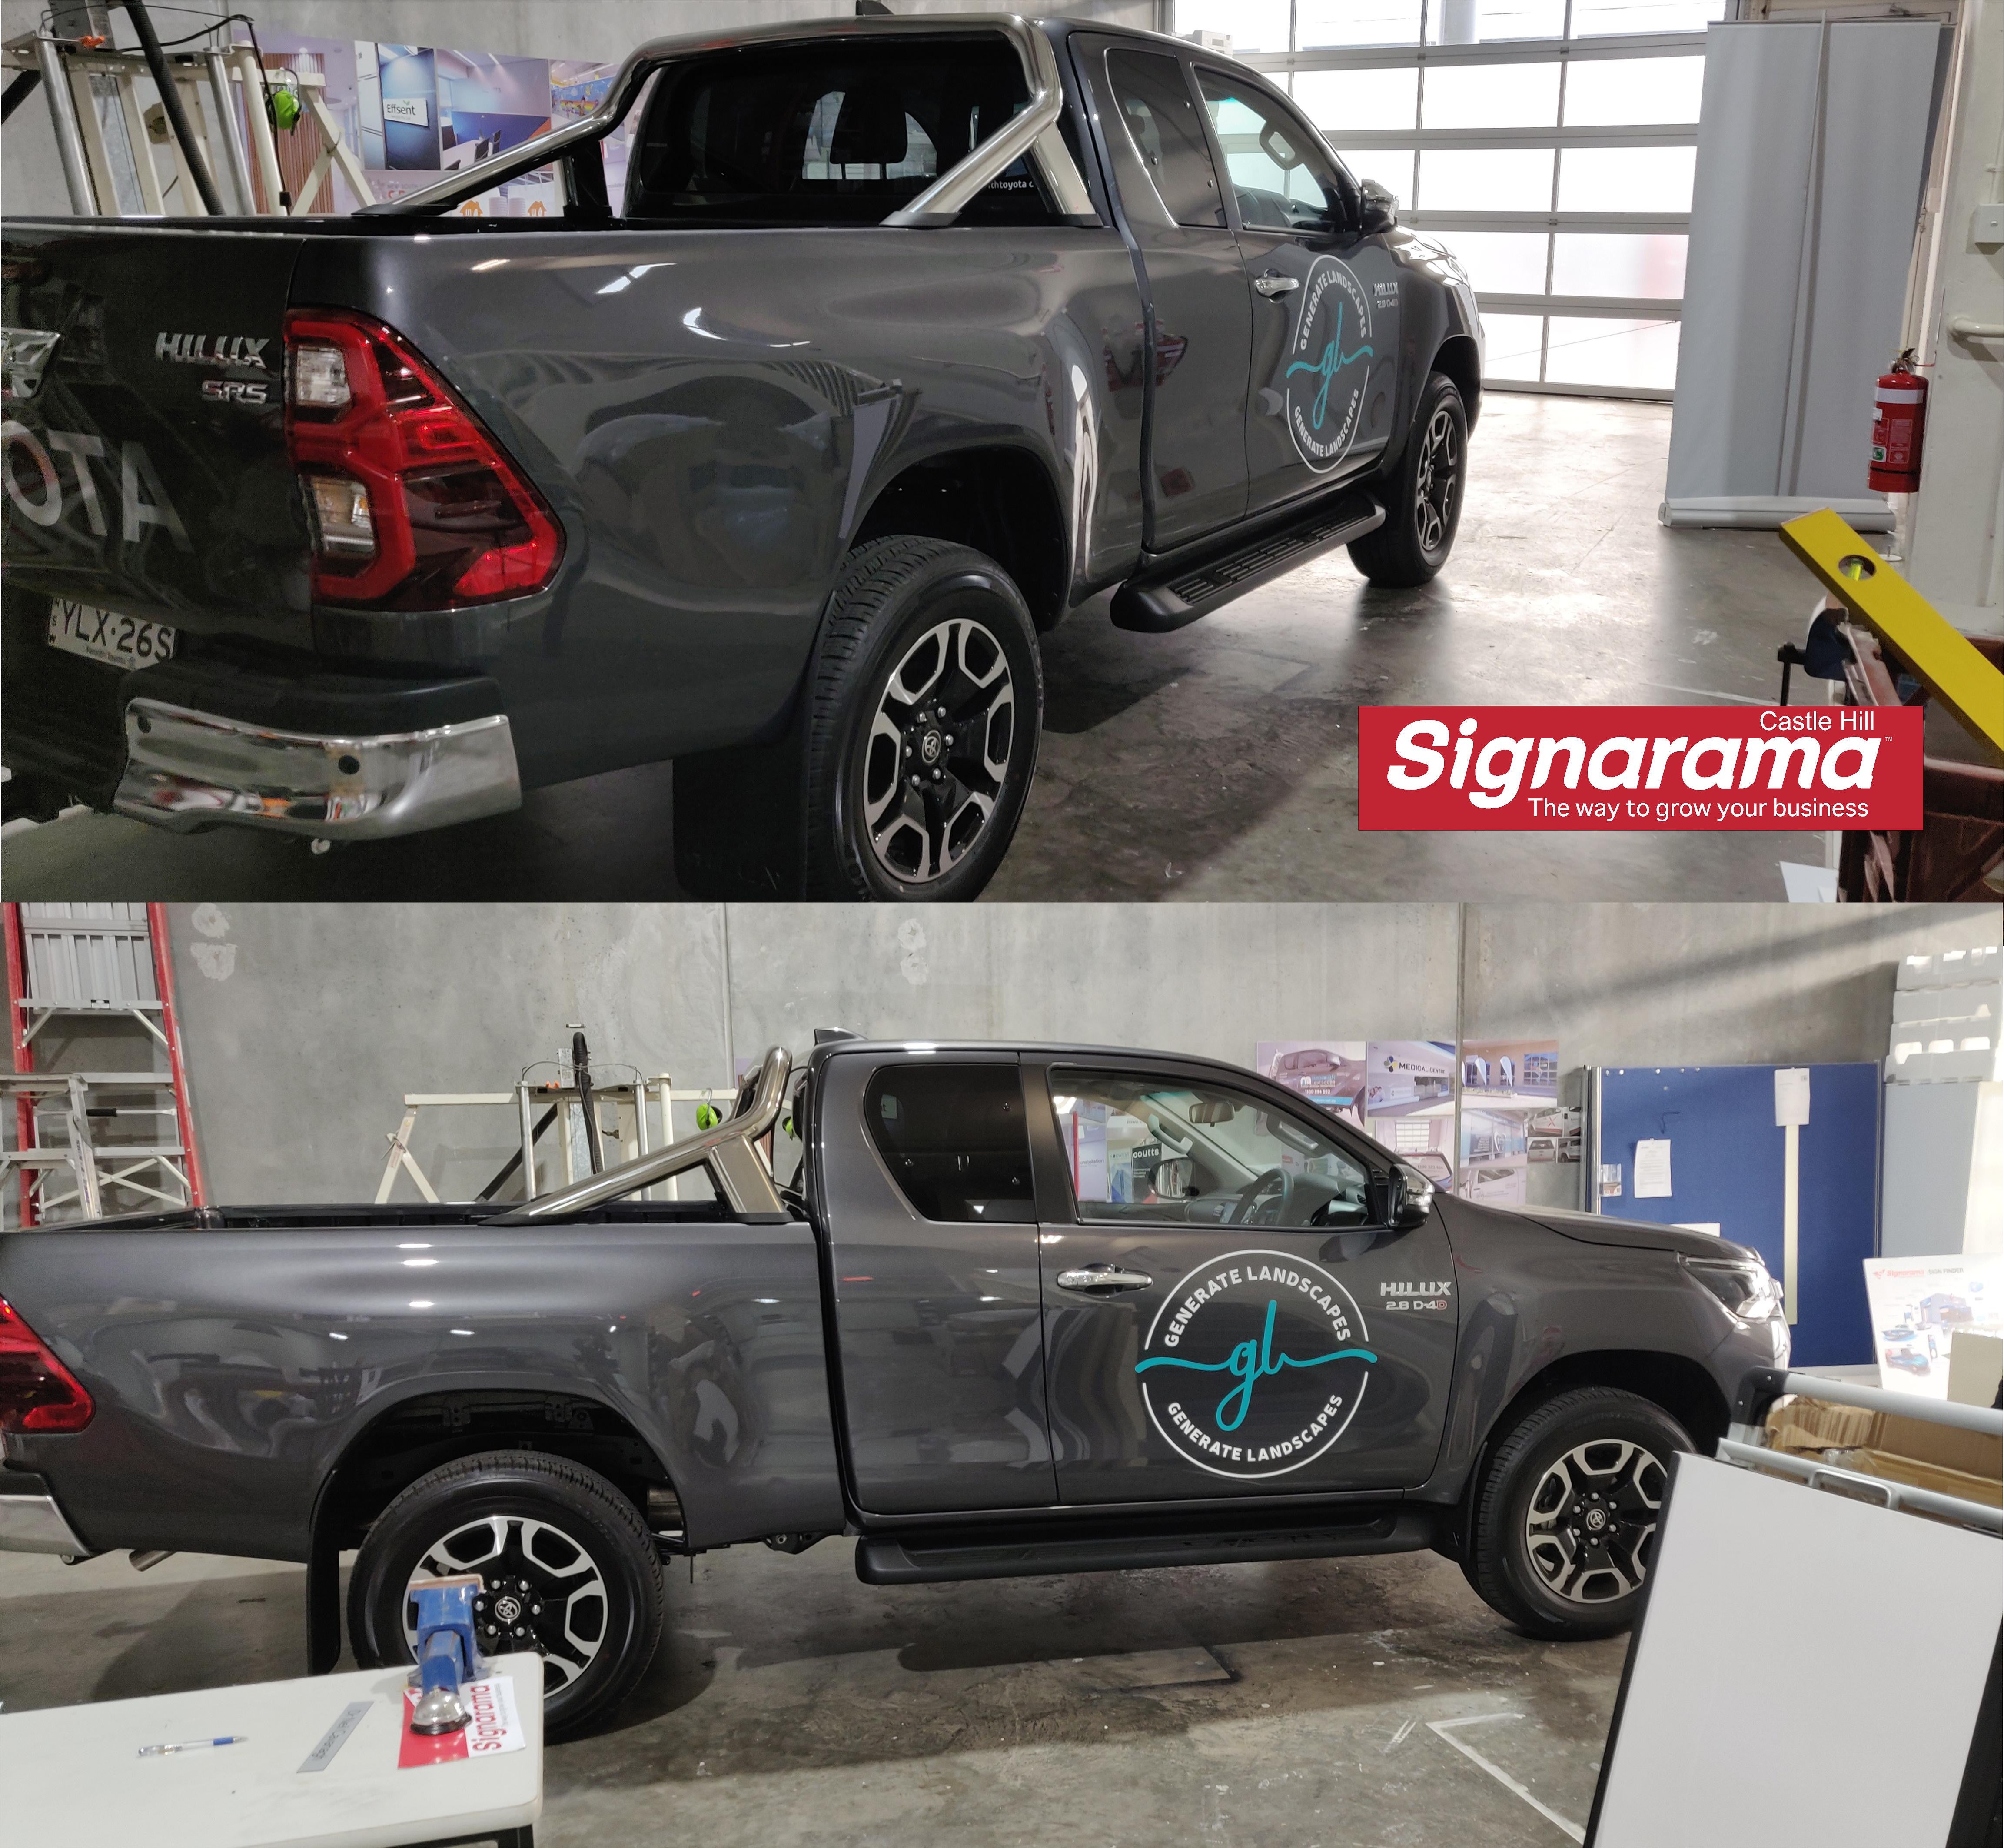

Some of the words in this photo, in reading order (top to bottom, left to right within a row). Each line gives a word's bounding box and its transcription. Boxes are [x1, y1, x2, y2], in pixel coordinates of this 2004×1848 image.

[386, 103, 416, 116] Effsent
[1300, 273, 1328, 351] GENERATE
[1326, 270, 1366, 339] LANDSCAPES
[155, 332, 270, 369] HILUX
[1294, 405, 1324, 457] GENERATE
[1324, 389, 1359, 457] LANDSCAPES
[1164, 1268, 1243, 1347] GENERATE
[1246, 1266, 1351, 1342] LANDSCAPES
[1380, 1281, 1452, 1296] HILUX
[1168, 1402, 1242, 1461] GENERATE
[1247, 1394, 1343, 1462] LANDSCAPES
[470, 1685, 507, 1752] Signarama
